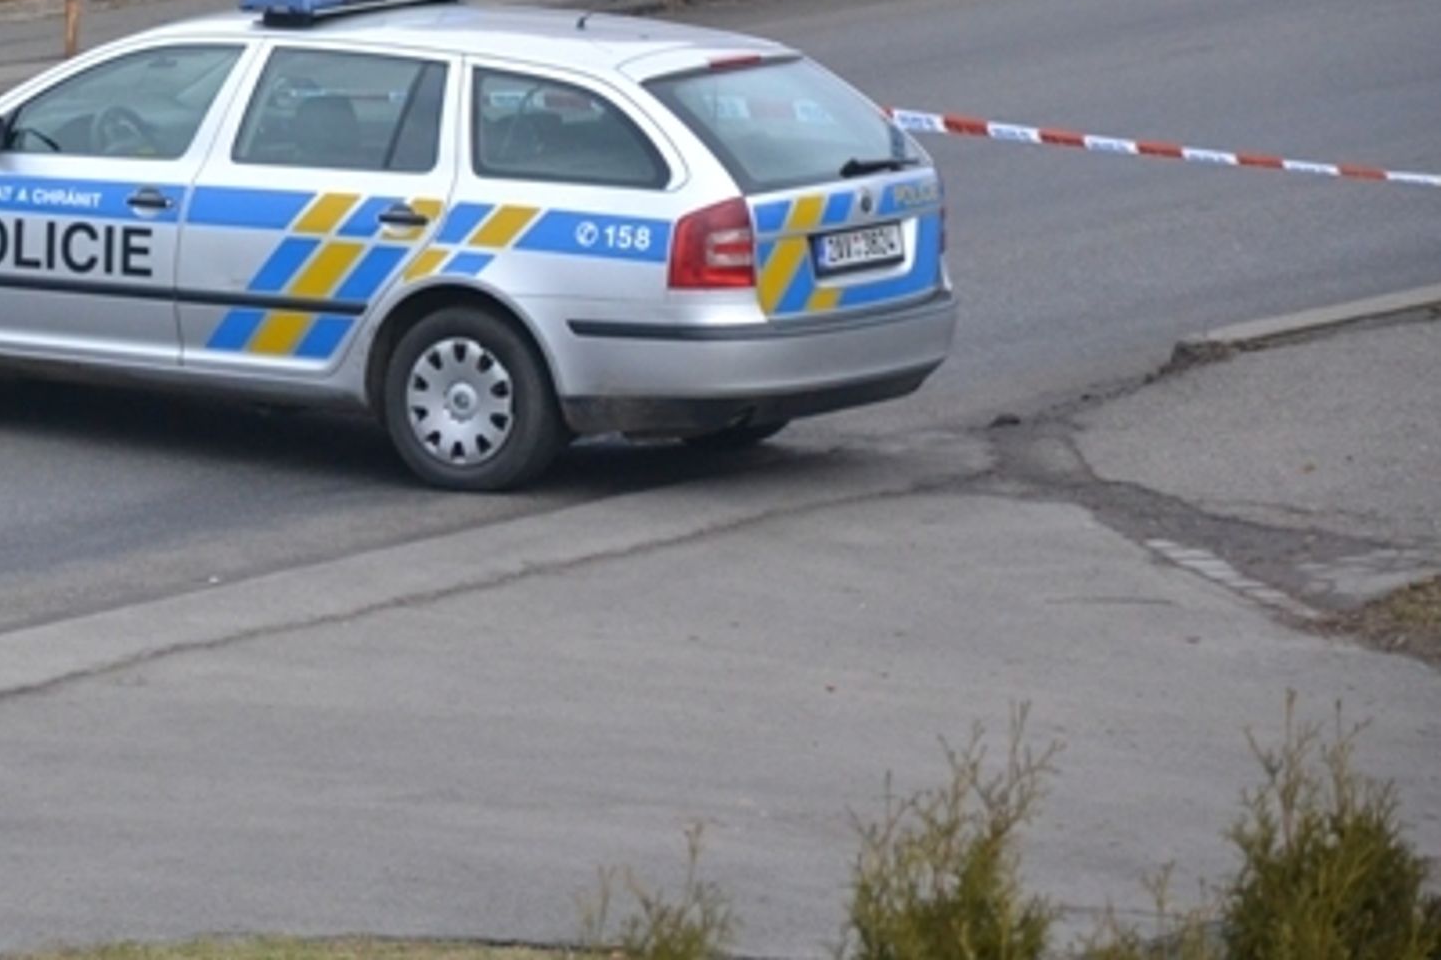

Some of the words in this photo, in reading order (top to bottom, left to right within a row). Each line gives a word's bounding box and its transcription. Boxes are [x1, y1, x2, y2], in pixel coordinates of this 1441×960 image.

[16, 188, 28, 203] A
[32, 187, 103, 208] CHRÁNIT
[604, 225, 651, 251] 158
